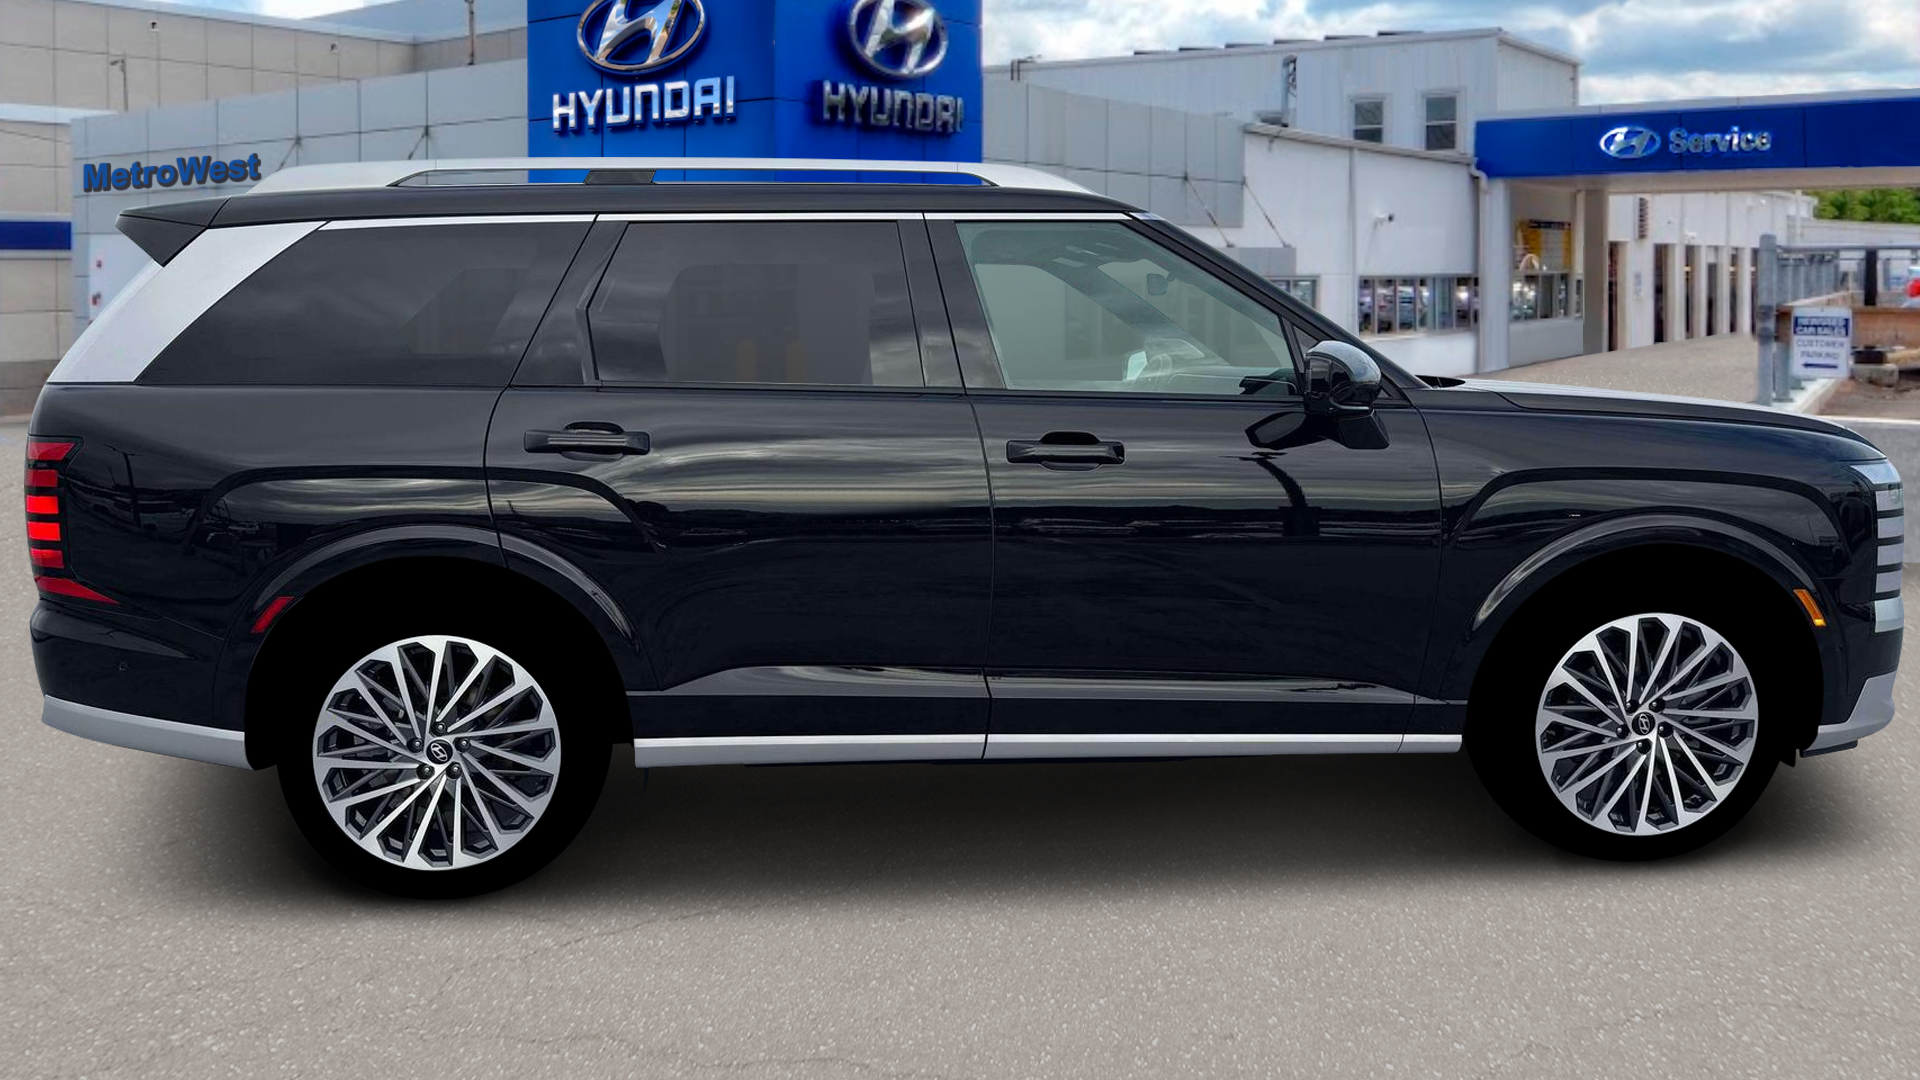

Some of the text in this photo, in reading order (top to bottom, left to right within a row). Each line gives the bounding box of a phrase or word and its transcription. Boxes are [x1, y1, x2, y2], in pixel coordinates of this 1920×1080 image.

[552, 76, 735, 132] HYUNDAI
[823, 80, 963, 133] HYUNDAI
[1669, 126, 1772, 154] Service
[83, 153, 262, 191] MetroWest
